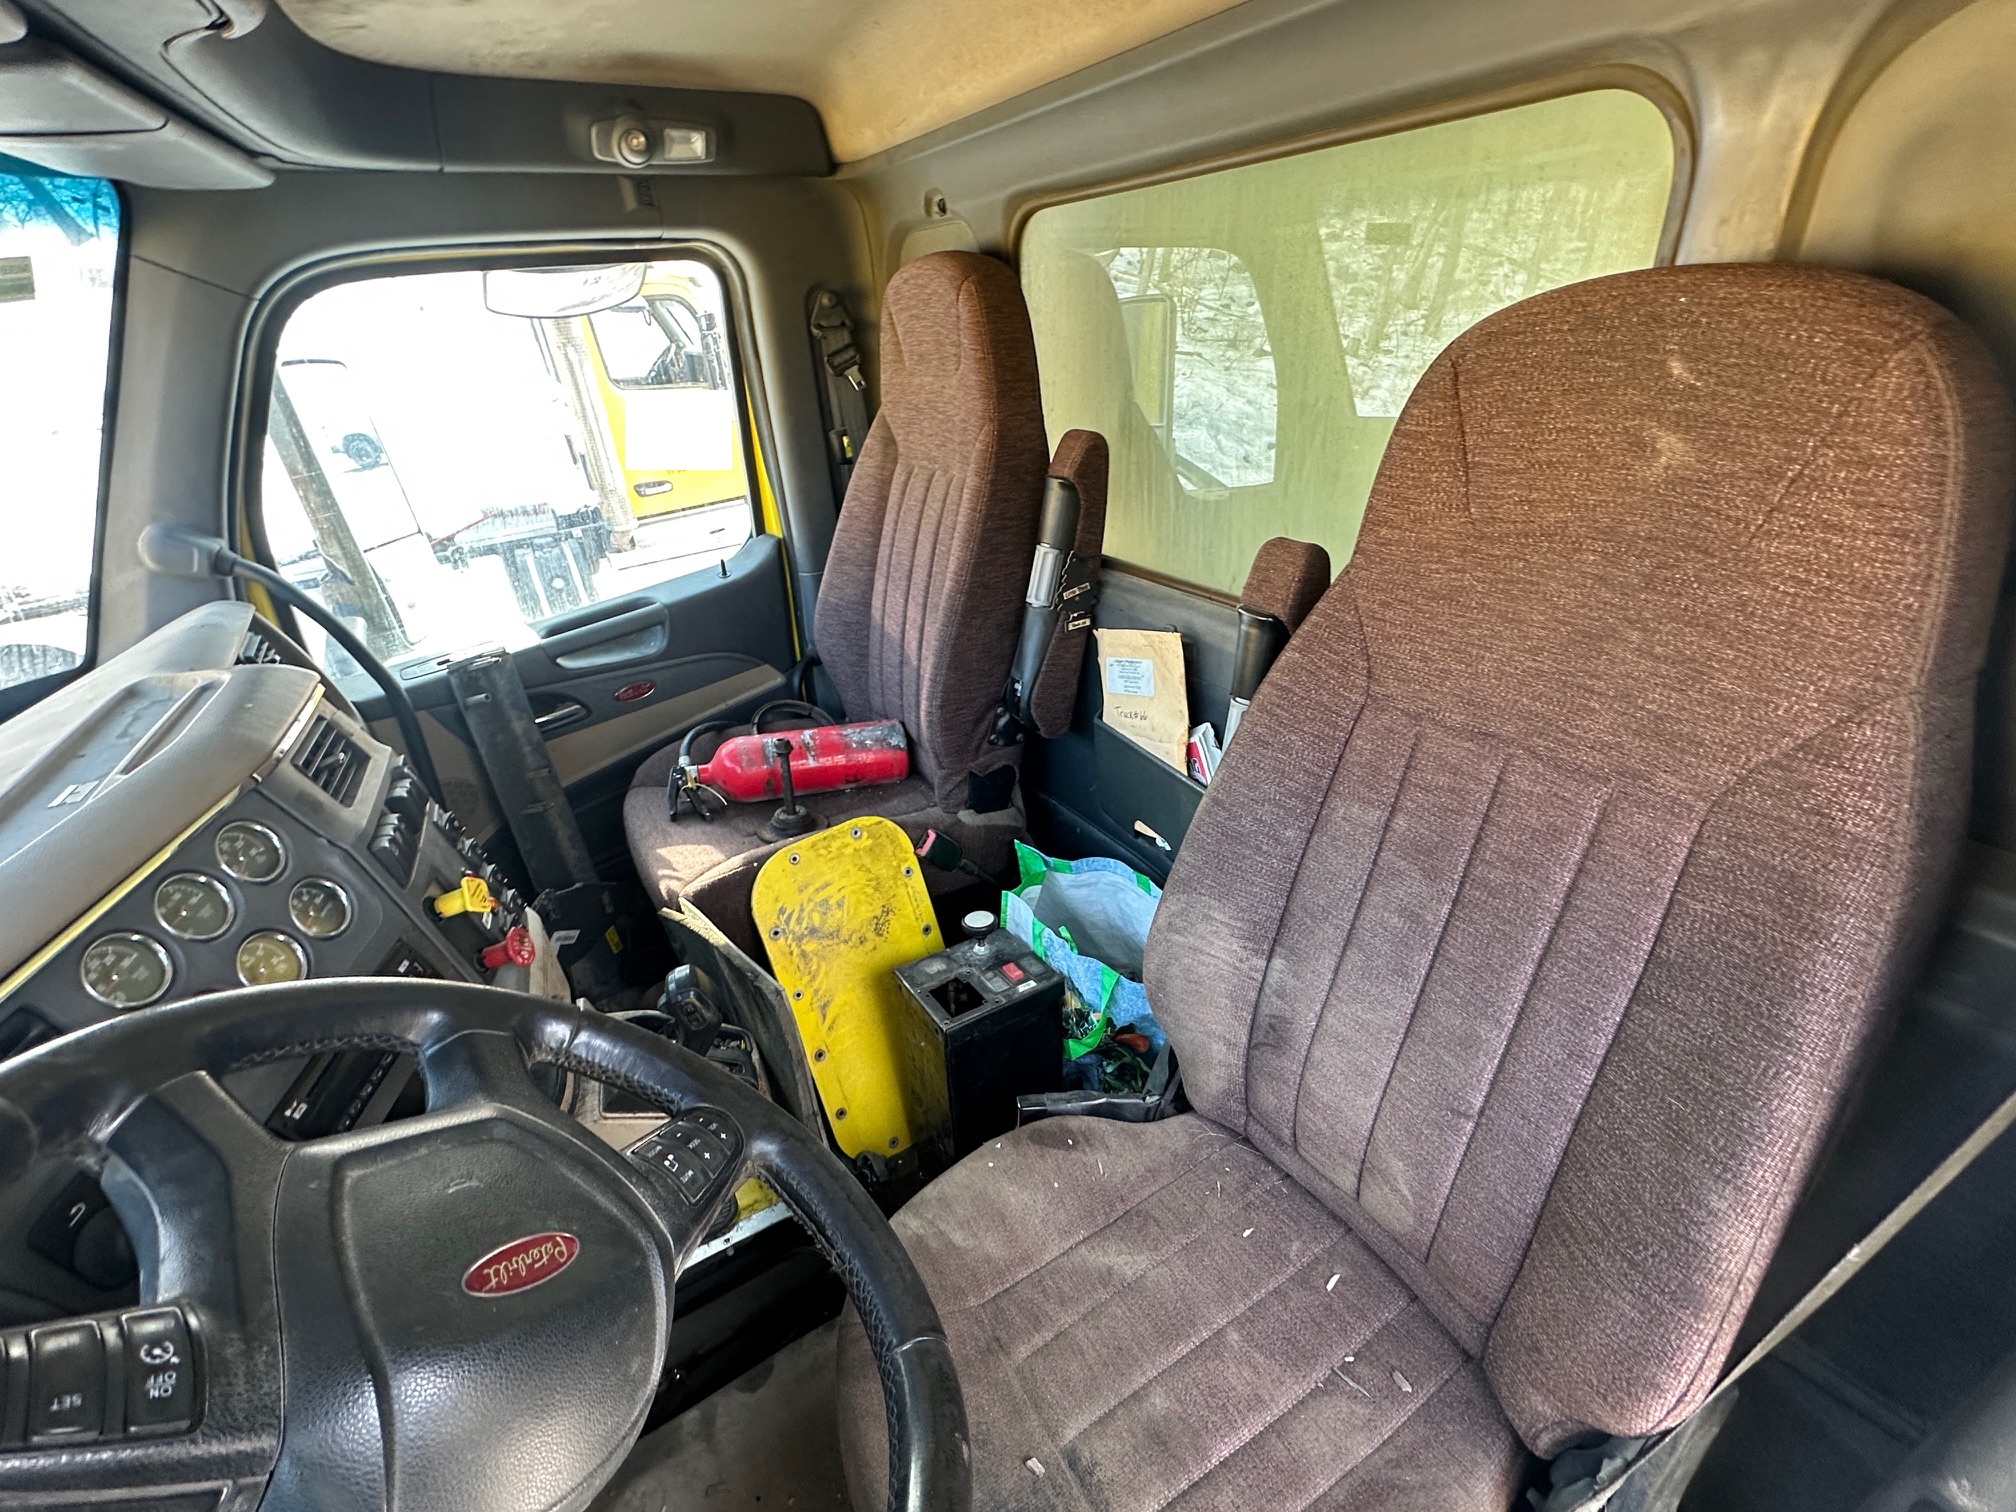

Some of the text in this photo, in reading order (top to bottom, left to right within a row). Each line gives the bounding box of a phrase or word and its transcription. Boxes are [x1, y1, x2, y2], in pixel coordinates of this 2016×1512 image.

[680, 1169, 694, 1184] MUTE
[482, 1236, 568, 1292] Peterbilt
[146, 1371, 177, 1389] OFF
[149, 1385, 172, 1400] ON
[50, 1393, 82, 1411] SET
